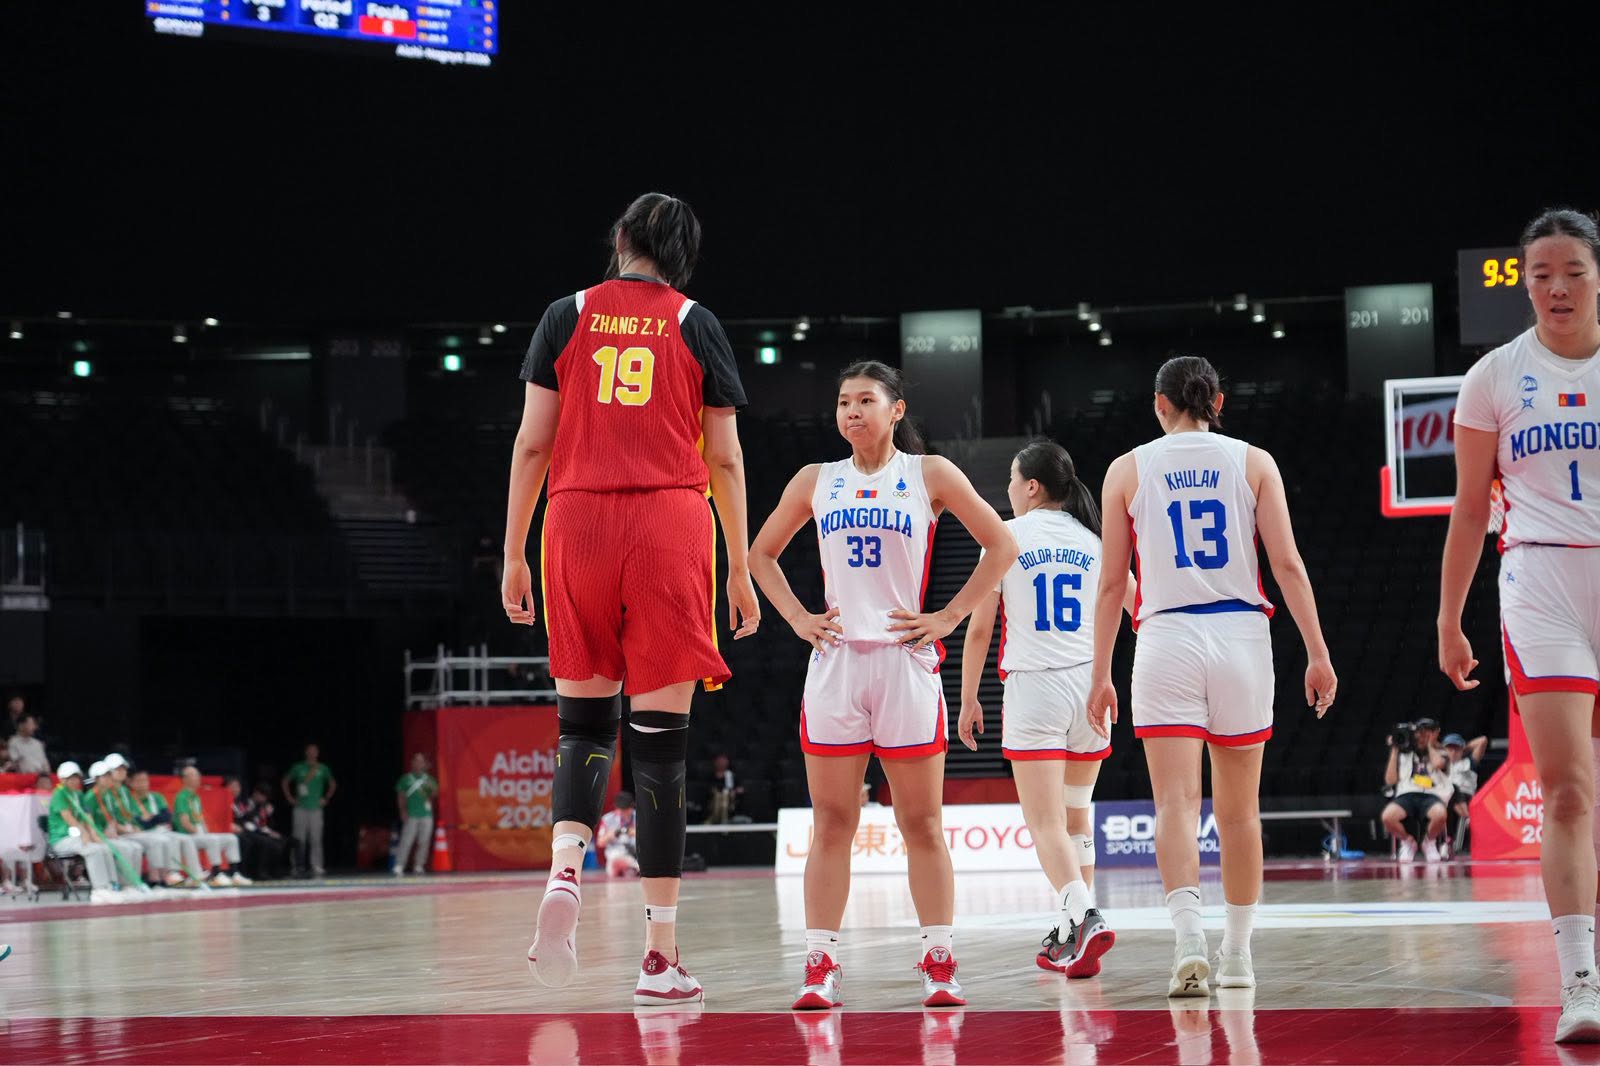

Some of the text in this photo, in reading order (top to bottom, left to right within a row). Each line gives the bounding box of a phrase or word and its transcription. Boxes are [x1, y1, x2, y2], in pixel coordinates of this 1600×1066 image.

[1483, 258, 1519, 288] 9.5
[590, 313, 639, 335] ZHANG
[1351, 307, 1430, 329] 201 201
[905, 335, 978, 353] 202 201
[592, 345, 655, 406] 19
[1511, 421, 1600, 462] MONGO
[1164, 469, 1220, 491] KHULAN
[1569, 460, 1582, 501] 1
[820, 507, 912, 540] MONGOLIA
[1167, 499, 1229, 570] 13
[847, 535, 881, 568] 33
[1018, 548, 1095, 572] BOLOR-ERDENE
[1033, 572, 1082, 632] 16
[479, 775, 554, 803] Nago
[497, 805, 553, 829] 202
[944, 826, 1035, 850] TOYO
